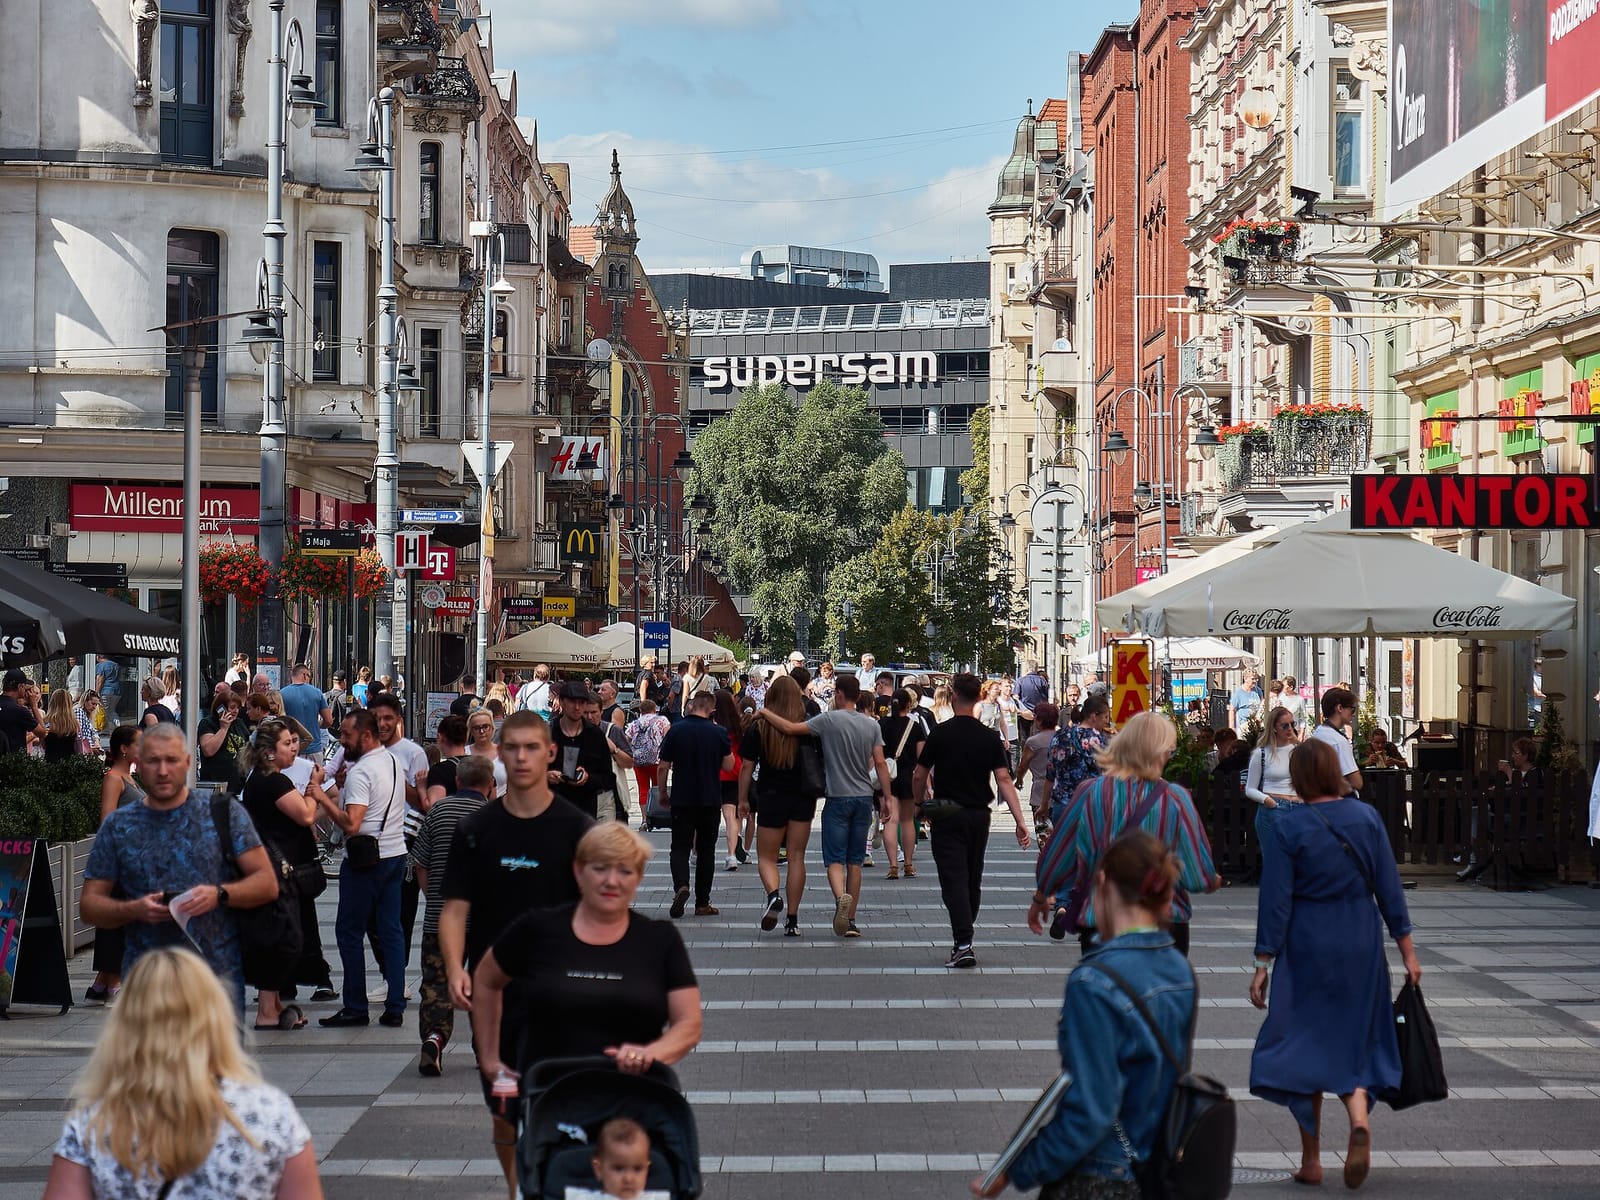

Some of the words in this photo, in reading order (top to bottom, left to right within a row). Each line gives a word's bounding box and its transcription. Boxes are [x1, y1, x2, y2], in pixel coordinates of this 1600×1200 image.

[703, 351, 938, 388] supersam
[1364, 476, 1590, 527] KANTOR
[198, 518, 219, 531] ank
[306, 537, 311, 546] 3
[313, 537, 331, 547] Maja
[441, 601, 470, 609] ORLEN
[544, 601, 569, 610] index
[644, 632, 669, 641] Policja
[123, 633, 180, 654] STARBUCKS
[494, 652, 521, 660] TYSKIE
[570, 654, 598, 662] TYSKIE
